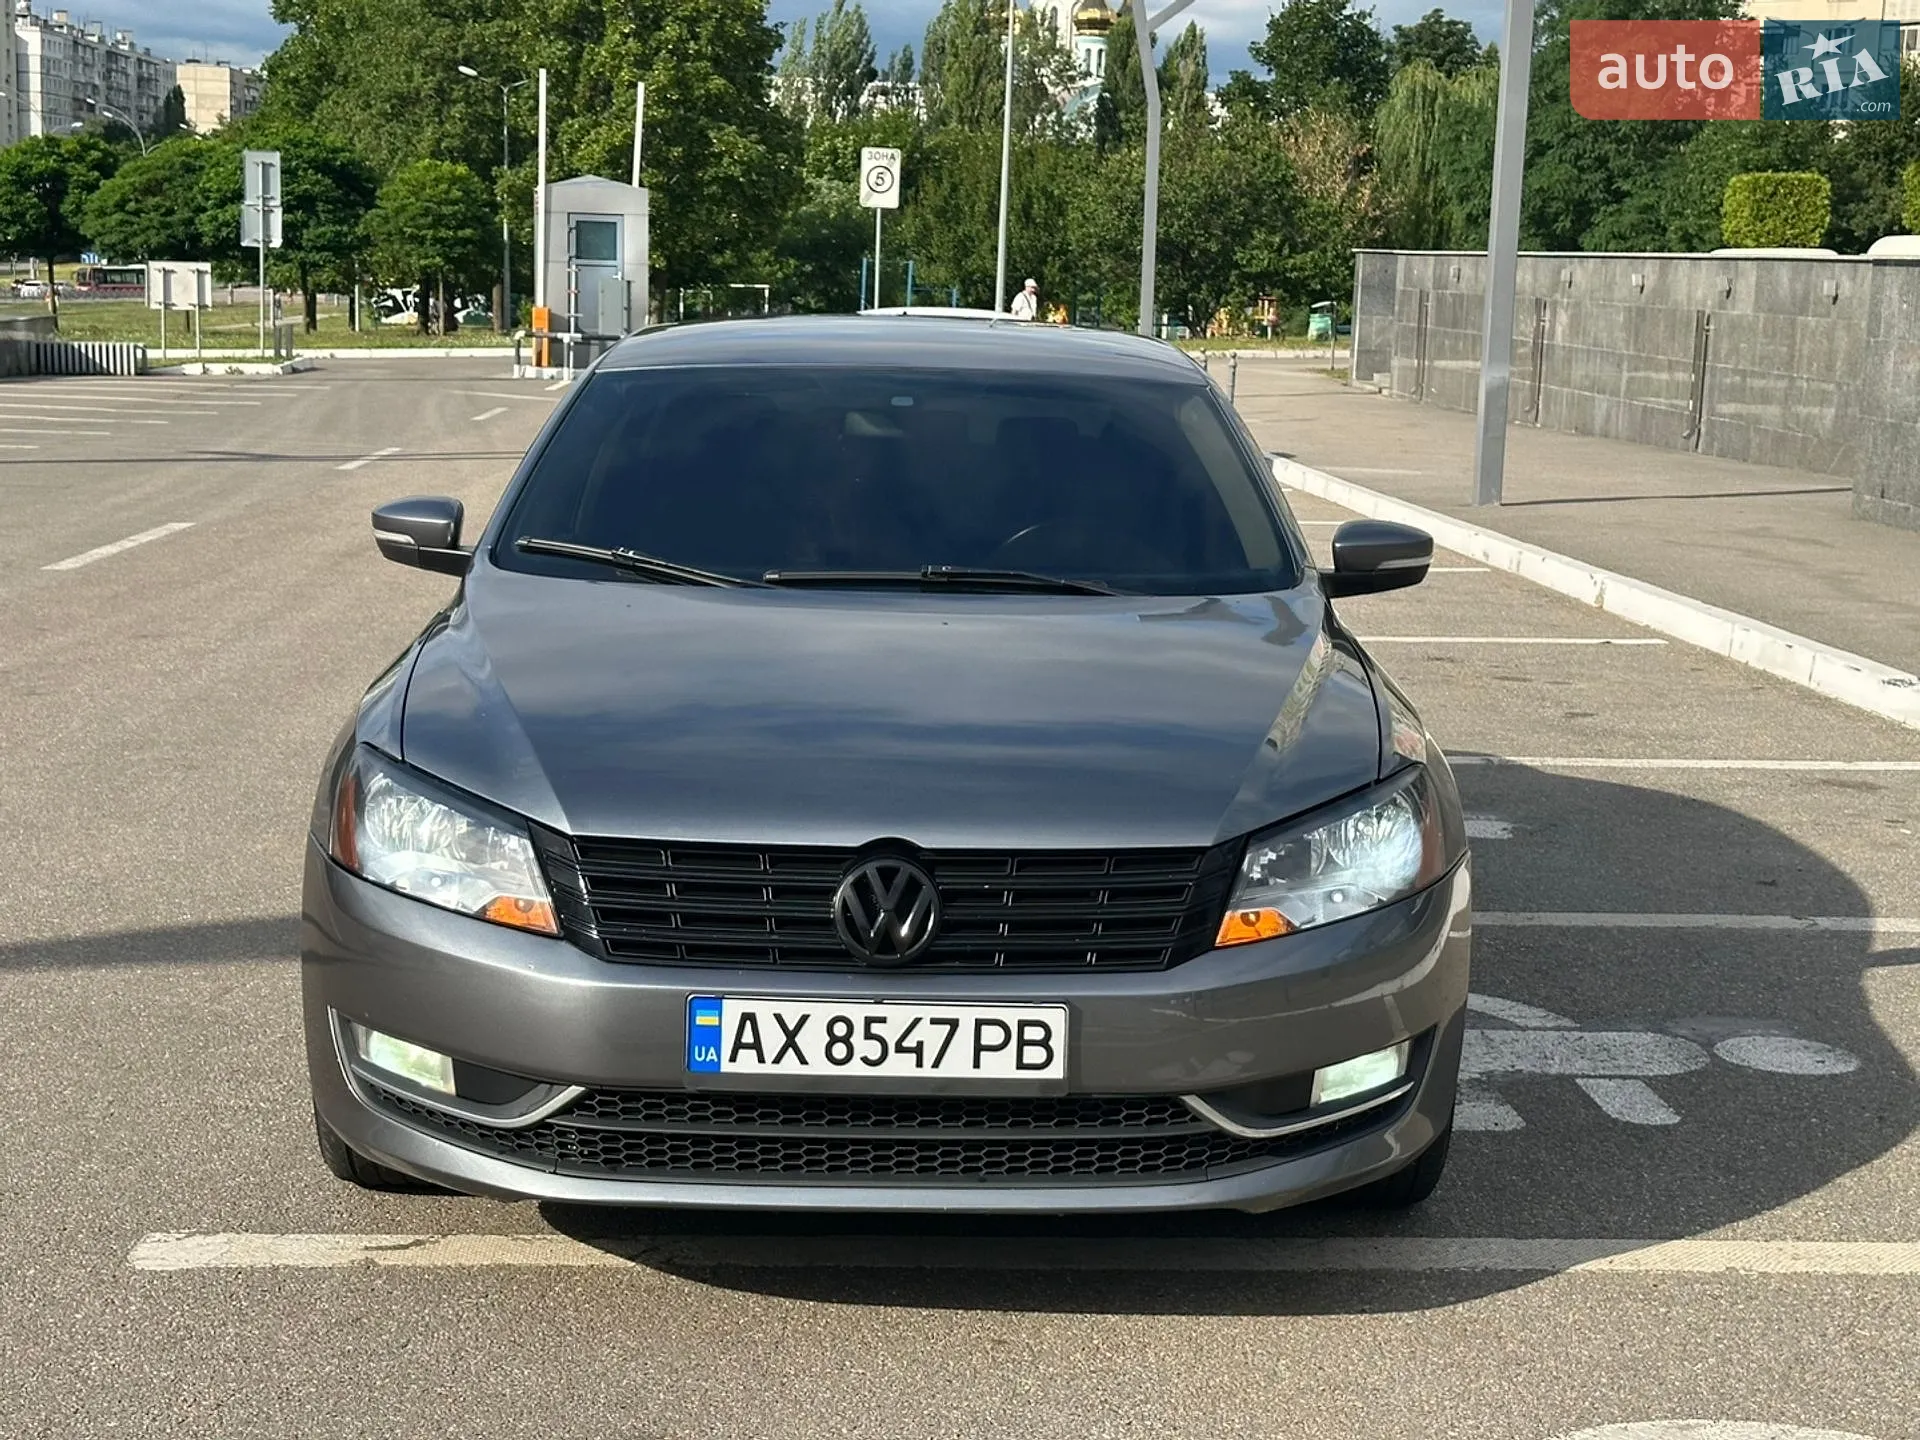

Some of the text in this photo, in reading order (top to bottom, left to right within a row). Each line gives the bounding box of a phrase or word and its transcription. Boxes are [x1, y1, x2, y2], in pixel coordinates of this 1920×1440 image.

[867, 151, 896, 161] ЗОНА
[875, 171, 885, 187] 5
[728, 1011, 1055, 1070] AX 8547 PB
[695, 1046, 718, 1062] UA
